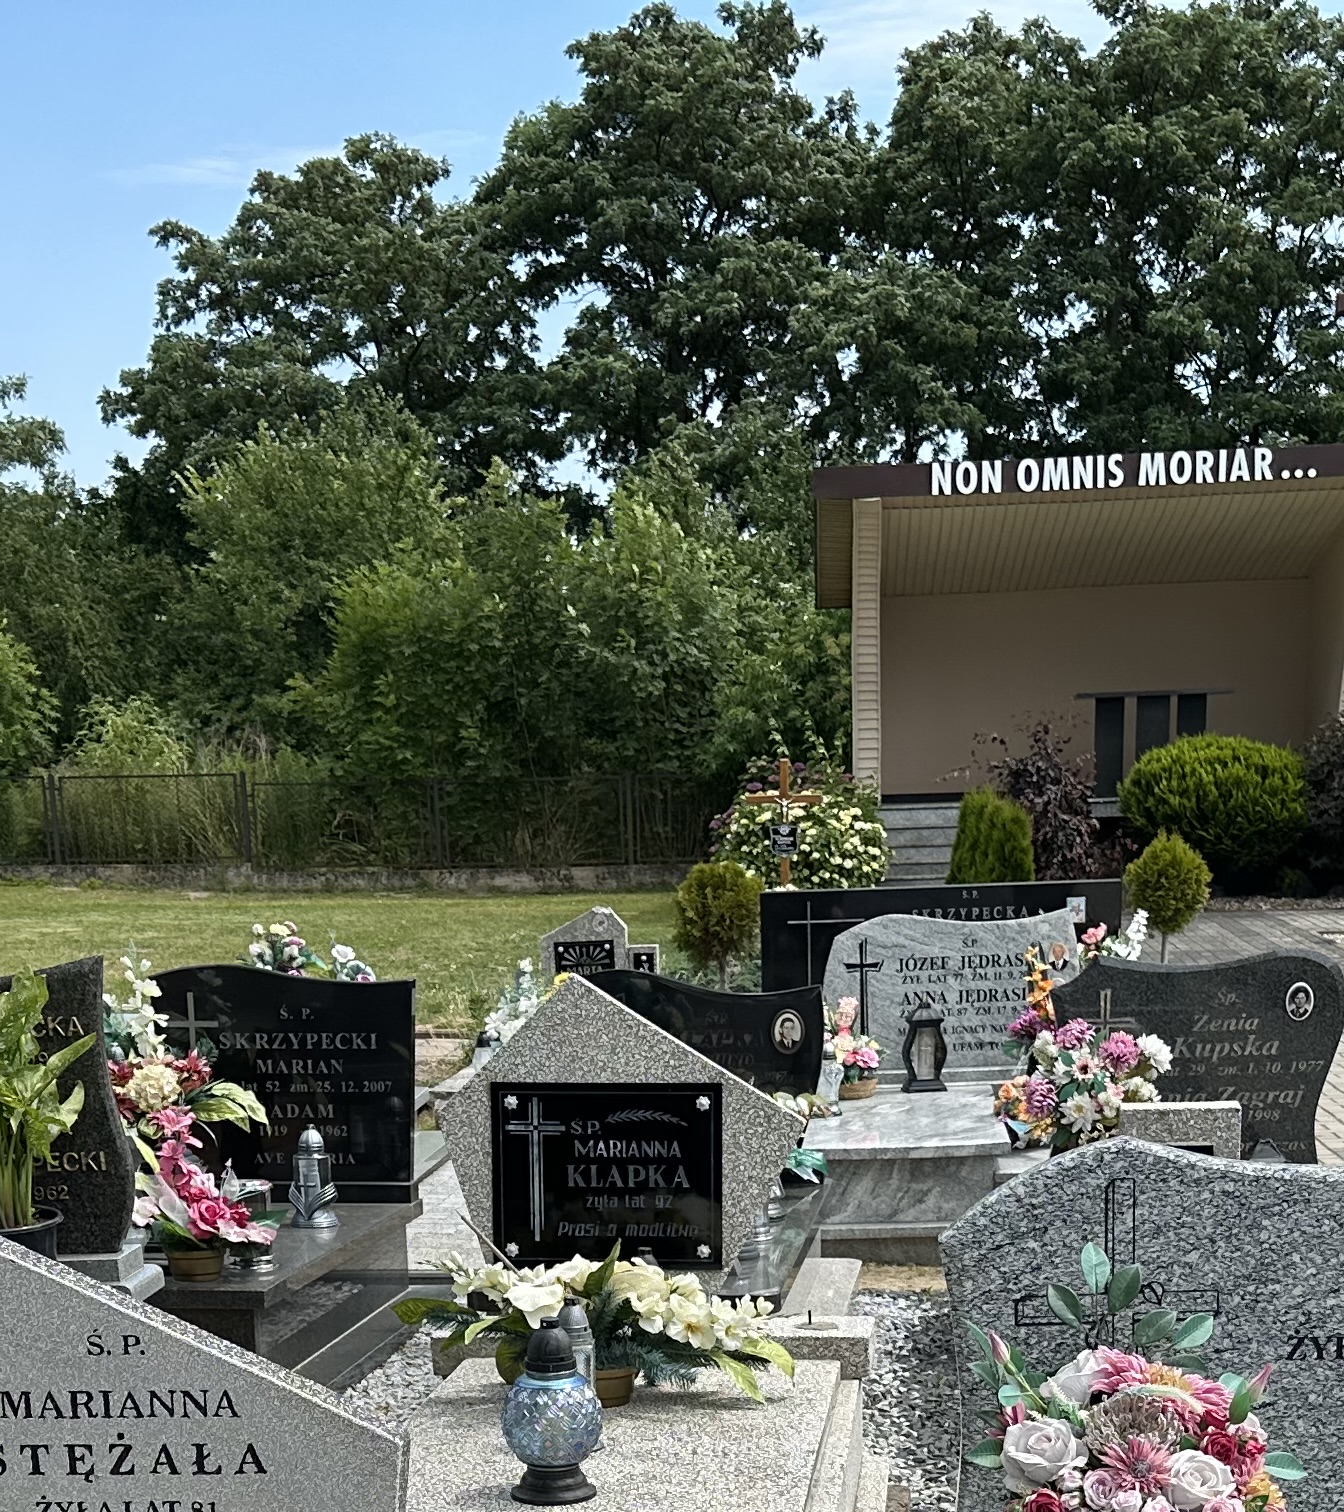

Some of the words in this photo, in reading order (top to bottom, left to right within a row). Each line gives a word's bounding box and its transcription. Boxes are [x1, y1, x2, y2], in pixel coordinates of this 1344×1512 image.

[931, 460, 1003, 496] NON
[1017, 454, 1125, 493] OMNIS
[1138, 447, 1318, 487] MORIAR...
[896, 953, 951, 974] JÓZEF
[958, 952, 1026, 973] JĘDRAS
[900, 989, 948, 1007] ANNA
[956, 986, 1027, 1008] JĘDRASI
[218, 1031, 378, 1051] SKRZYPECKI
[1173, 1034, 1281, 1064] Kupska
[256, 1058, 344, 1075] MARIAN
[1289, 1060, 1325, 1075] 1977
[265, 1080, 281, 1093] 52
[363, 1079, 393, 1093] 2007
[270, 1102, 336, 1119] ADAM
[255, 1151, 286, 1165] AVE
[574, 1139, 682, 1159] MARIANNA
[566, 1163, 692, 1189] KLAPKA
[33, 1184, 70, 1201] 962
[557, 1219, 601, 1238] Prosi
[0, 1389, 241, 1420] MARIANNA
